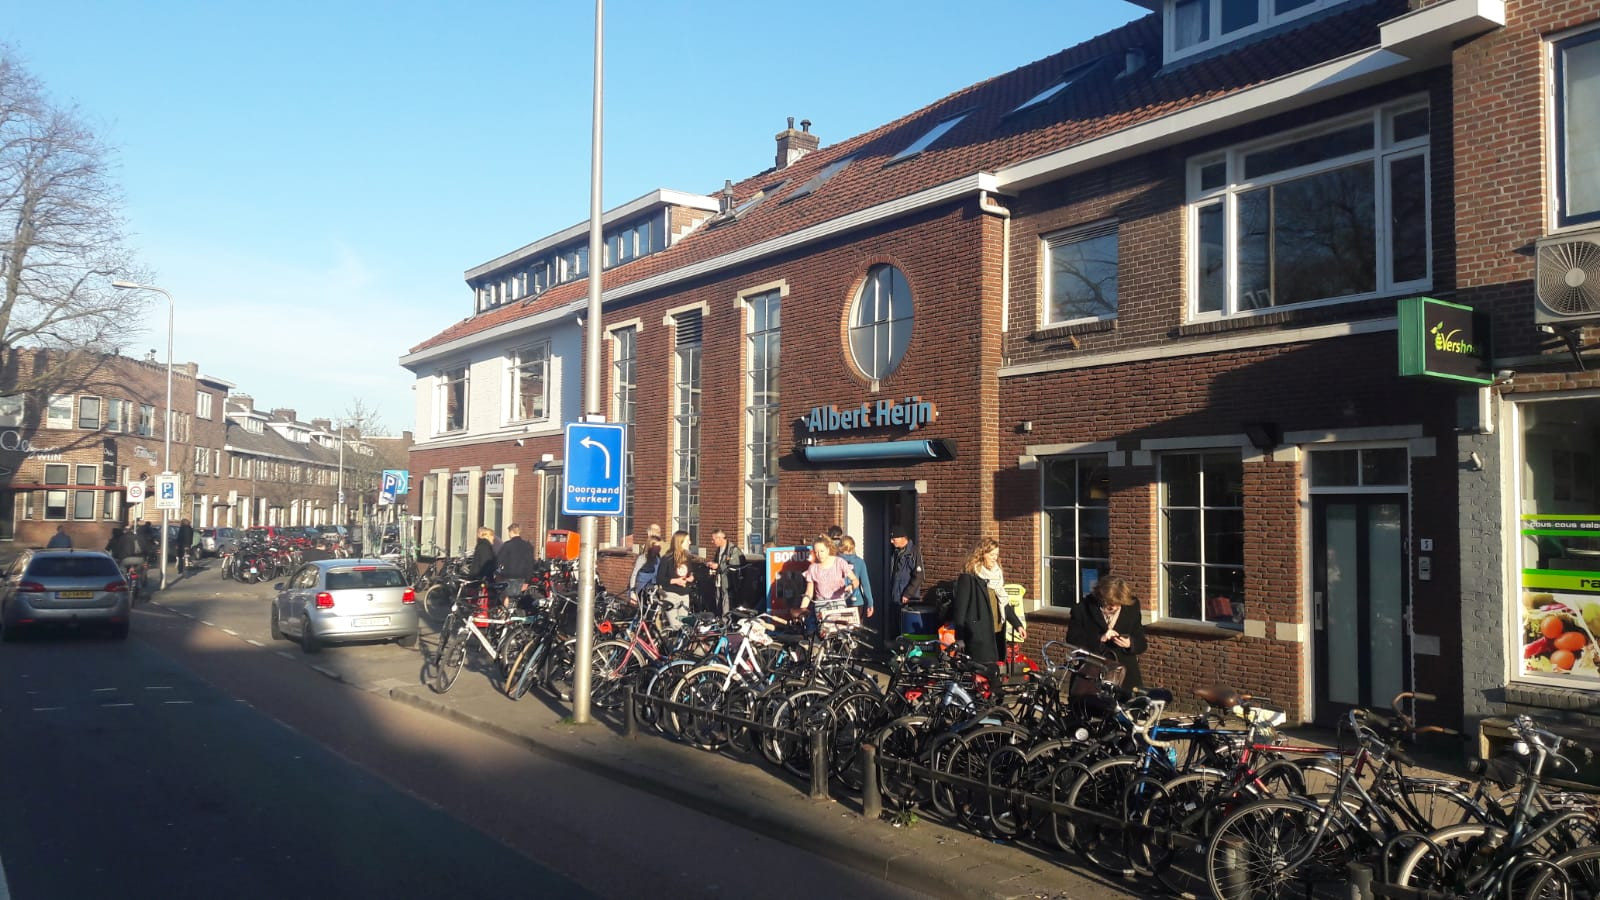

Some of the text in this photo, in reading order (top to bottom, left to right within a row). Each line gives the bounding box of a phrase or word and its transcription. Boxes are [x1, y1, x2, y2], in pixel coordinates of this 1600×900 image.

[807, 396, 937, 432] Albert Heijn
[486, 473, 501, 485] PUNT
[568, 485, 620, 496] Doorgaand
[575, 494, 613, 503] verkeer
[773, 551, 812, 564] BONUS
